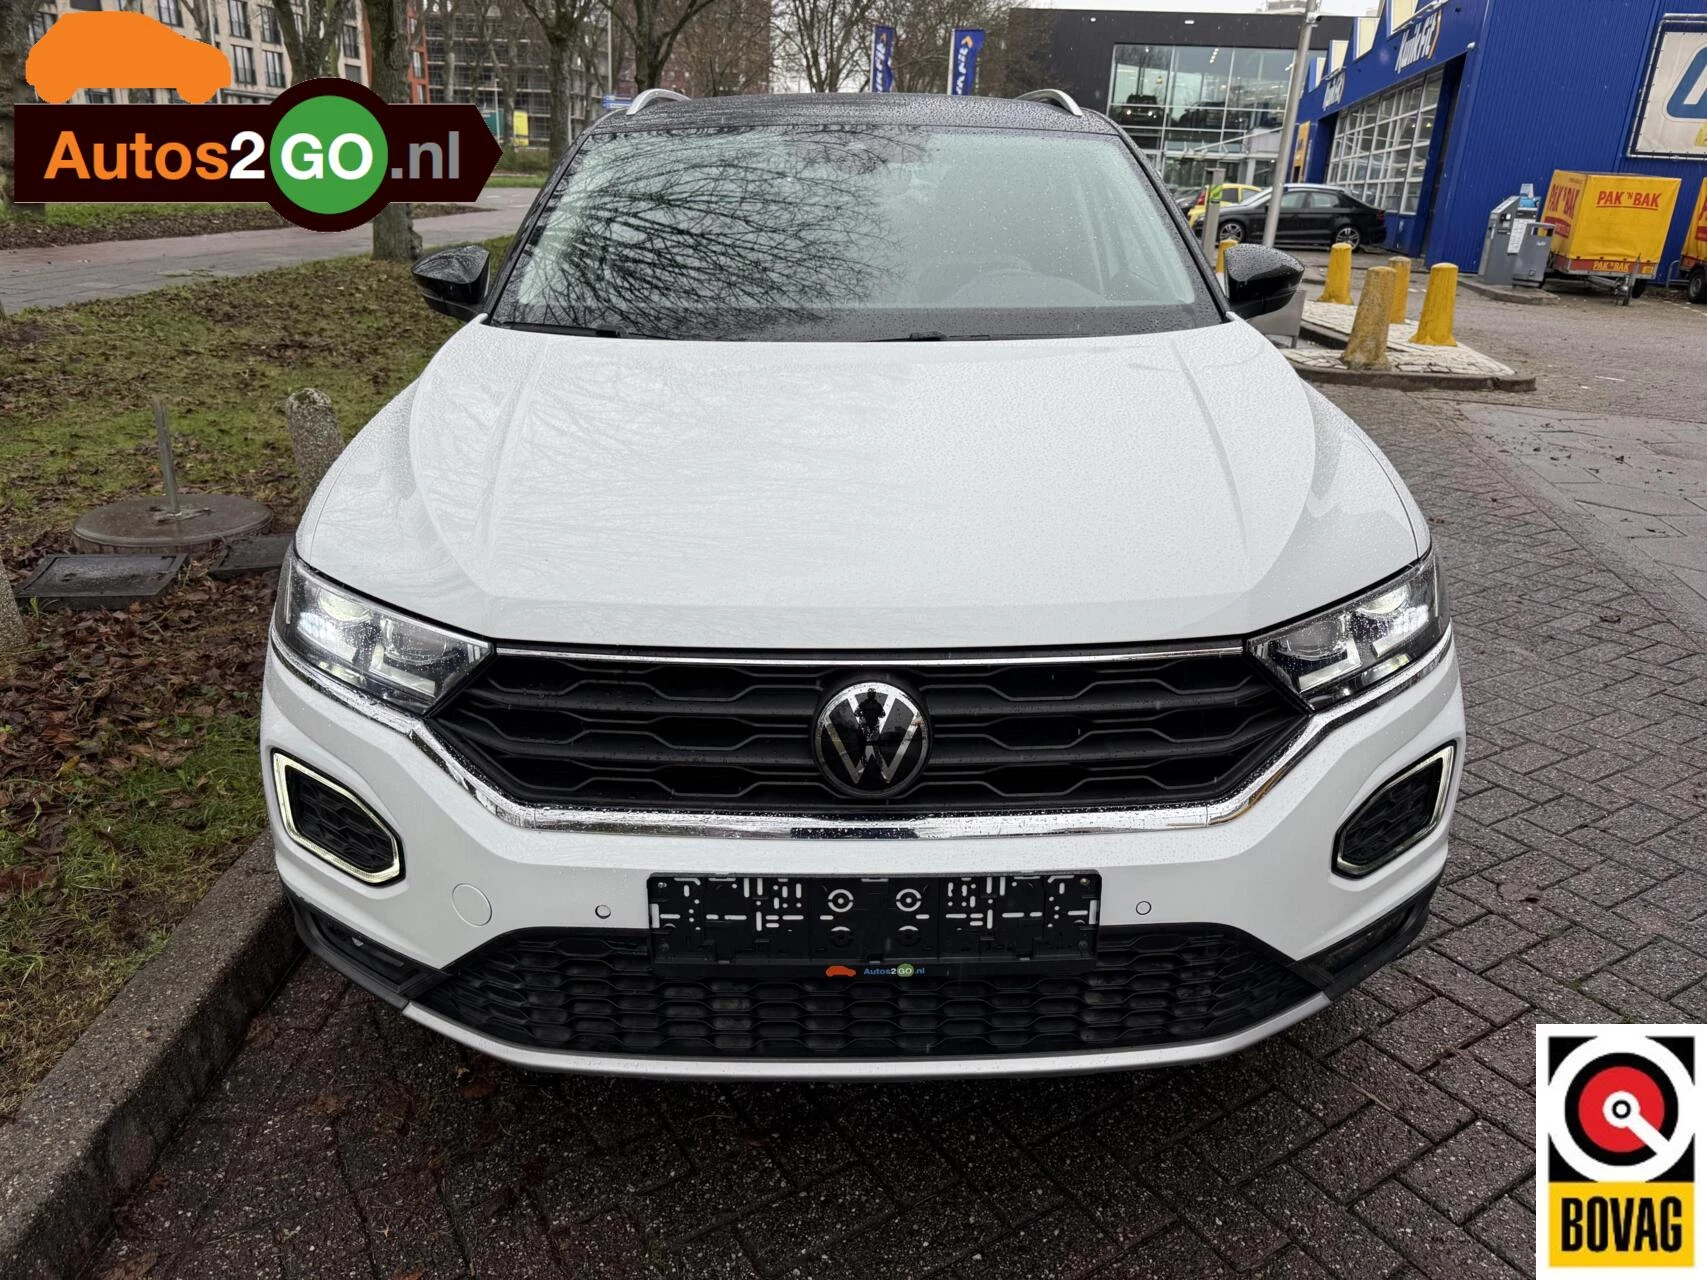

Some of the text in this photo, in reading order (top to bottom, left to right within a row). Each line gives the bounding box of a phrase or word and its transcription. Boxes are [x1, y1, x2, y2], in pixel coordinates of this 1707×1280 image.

[1597, 191, 1625, 205] PAK
[1633, 192, 1662, 208] BAK
[1592, 261, 1607, 271] PAK
[1613, 262, 1631, 273] BAK
[864, 967, 925, 976] Autos2GO.nl
